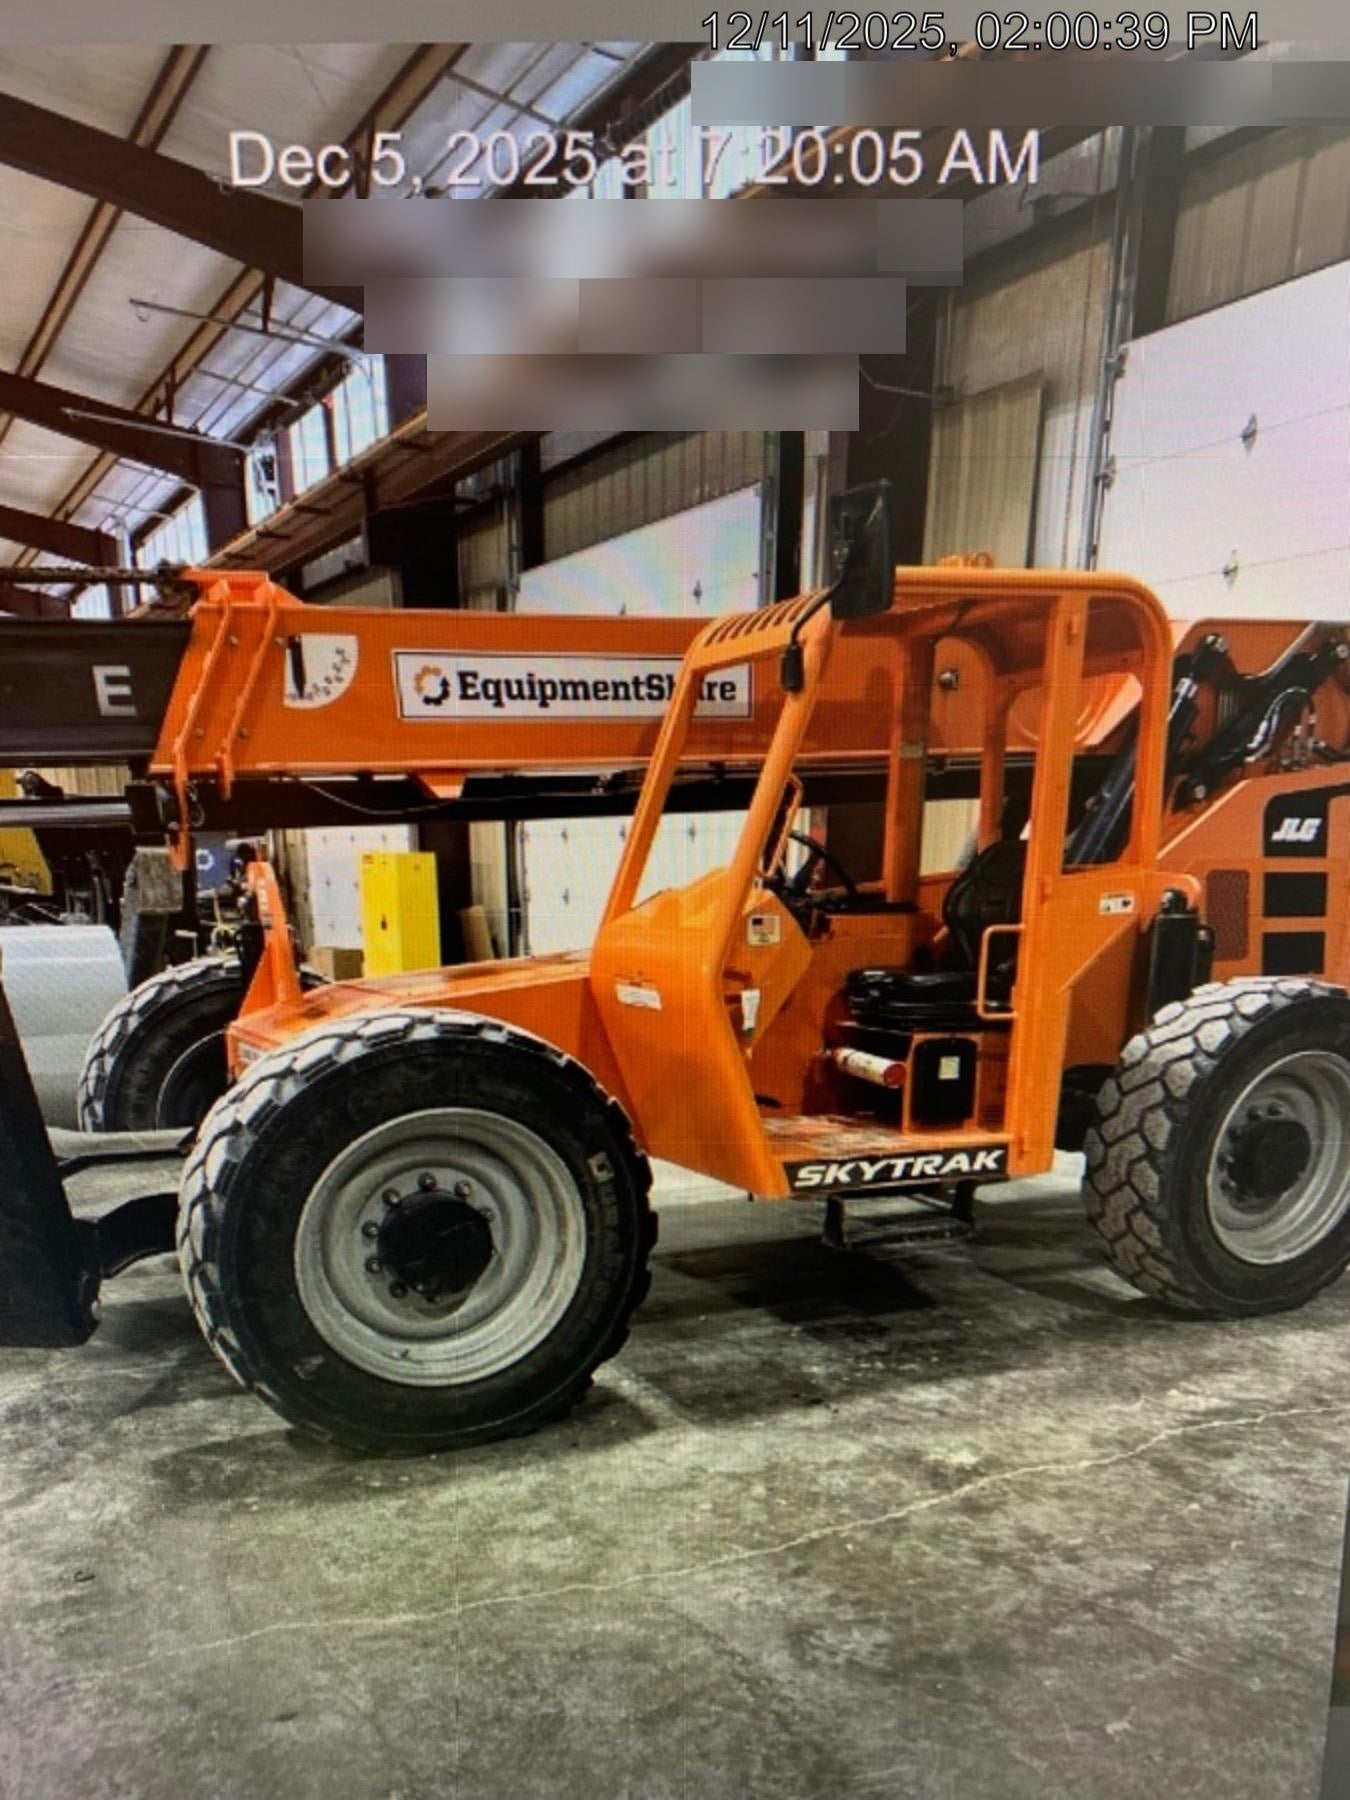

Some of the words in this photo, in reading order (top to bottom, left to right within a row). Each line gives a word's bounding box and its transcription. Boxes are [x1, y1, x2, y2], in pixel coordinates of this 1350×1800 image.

[92, 665, 137, 717] E
[457, 670, 736, 708] EquipmentSre
[1271, 817, 1323, 842] JLG
[794, 1150, 1004, 1187] SKYTRAK
